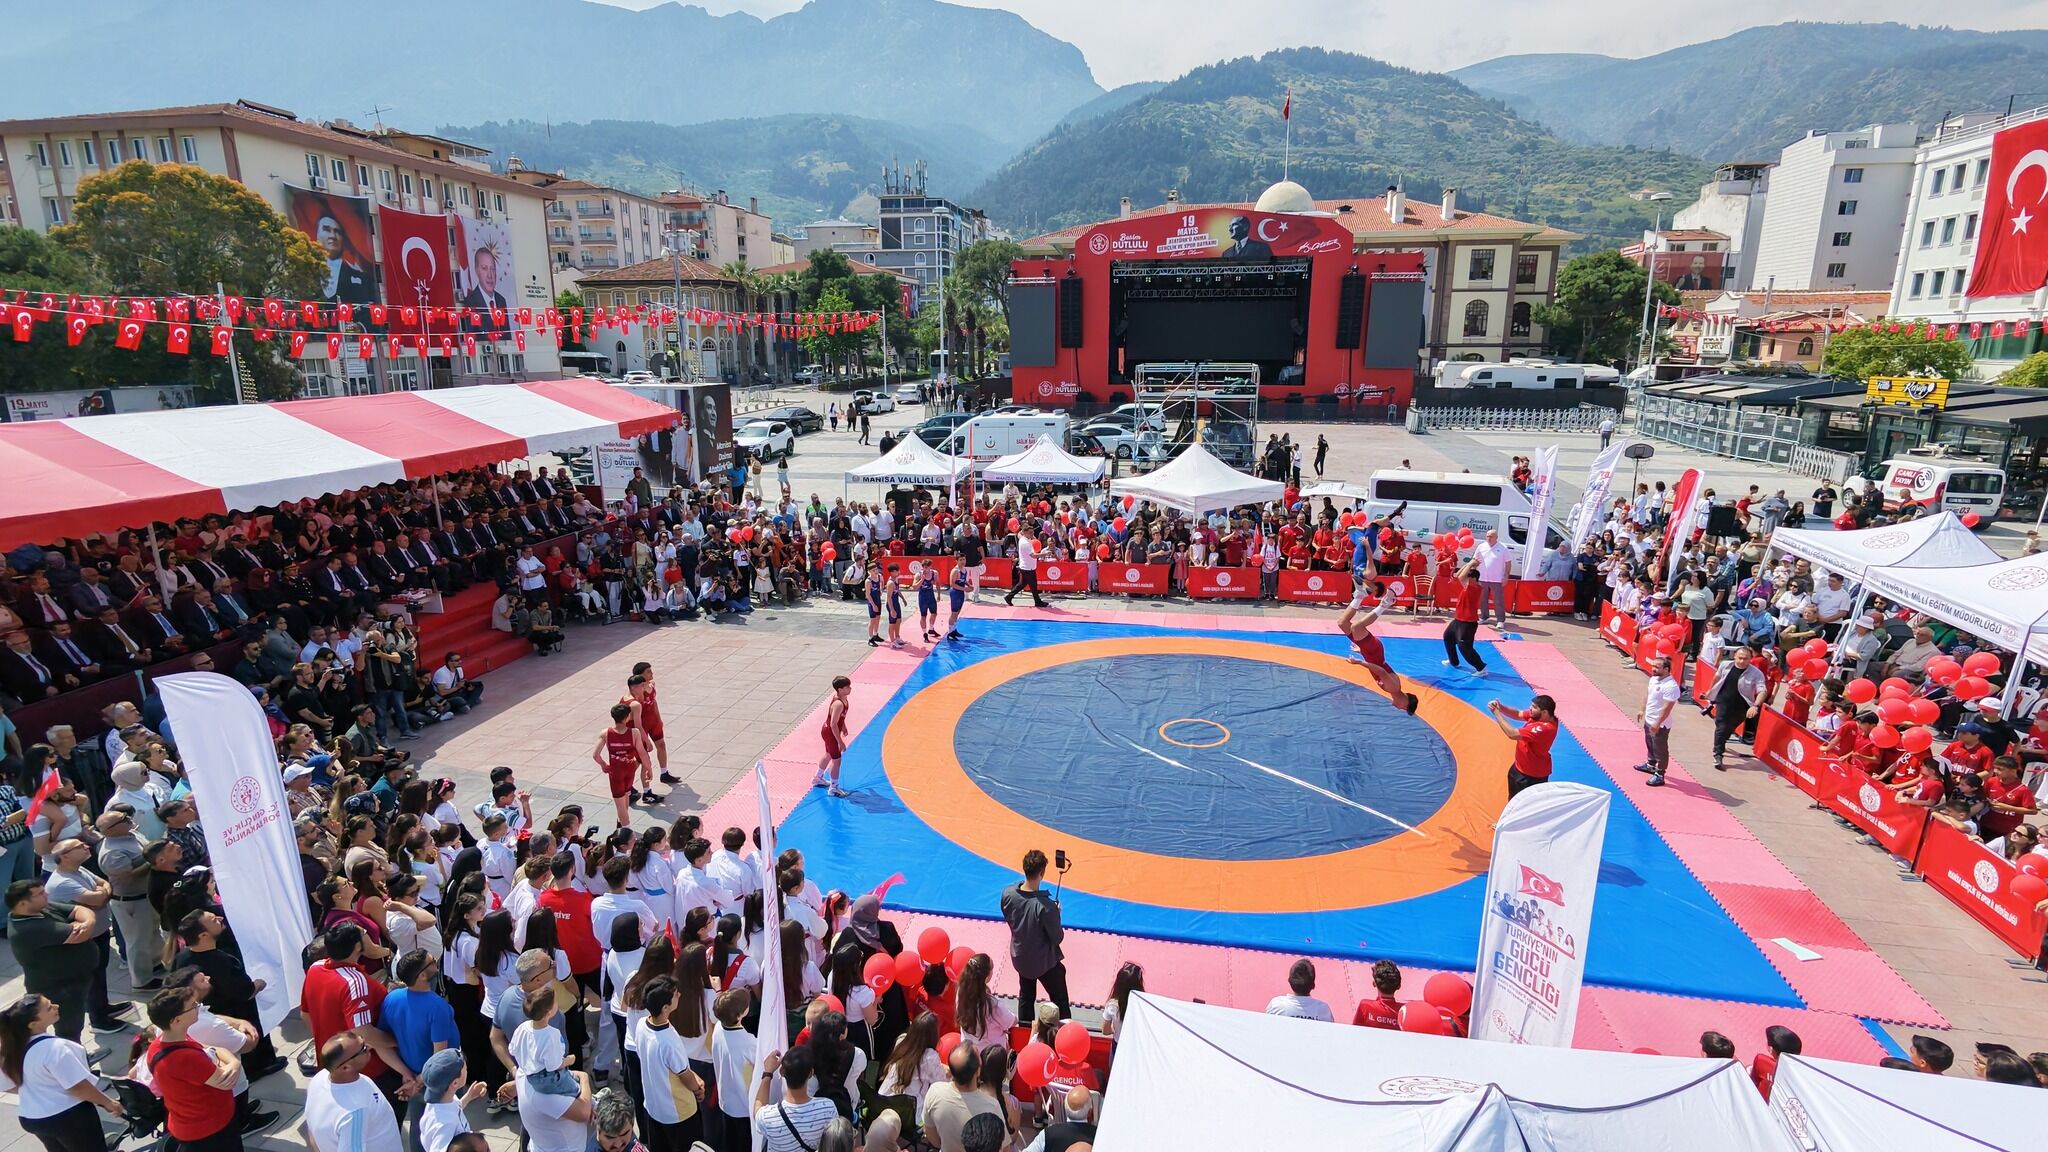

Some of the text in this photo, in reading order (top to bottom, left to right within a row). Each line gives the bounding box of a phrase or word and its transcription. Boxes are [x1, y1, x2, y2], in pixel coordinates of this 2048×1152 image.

[1182, 215, 1195, 227] 19
[1120, 233, 1142, 241] Besim
[1112, 240, 1148, 248] DUTLULU
[10, 398, 25, 410] 19
[1462, 522, 1493, 530] DUTLULU
[1911, 590, 1929, 605] MİLLİ
[1929, 599, 1952, 616] EĞİTİM
[1953, 608, 2002, 634] MÜDÜRLÜĞÜ
[1510, 940, 1550, 978] GÜCÜ
